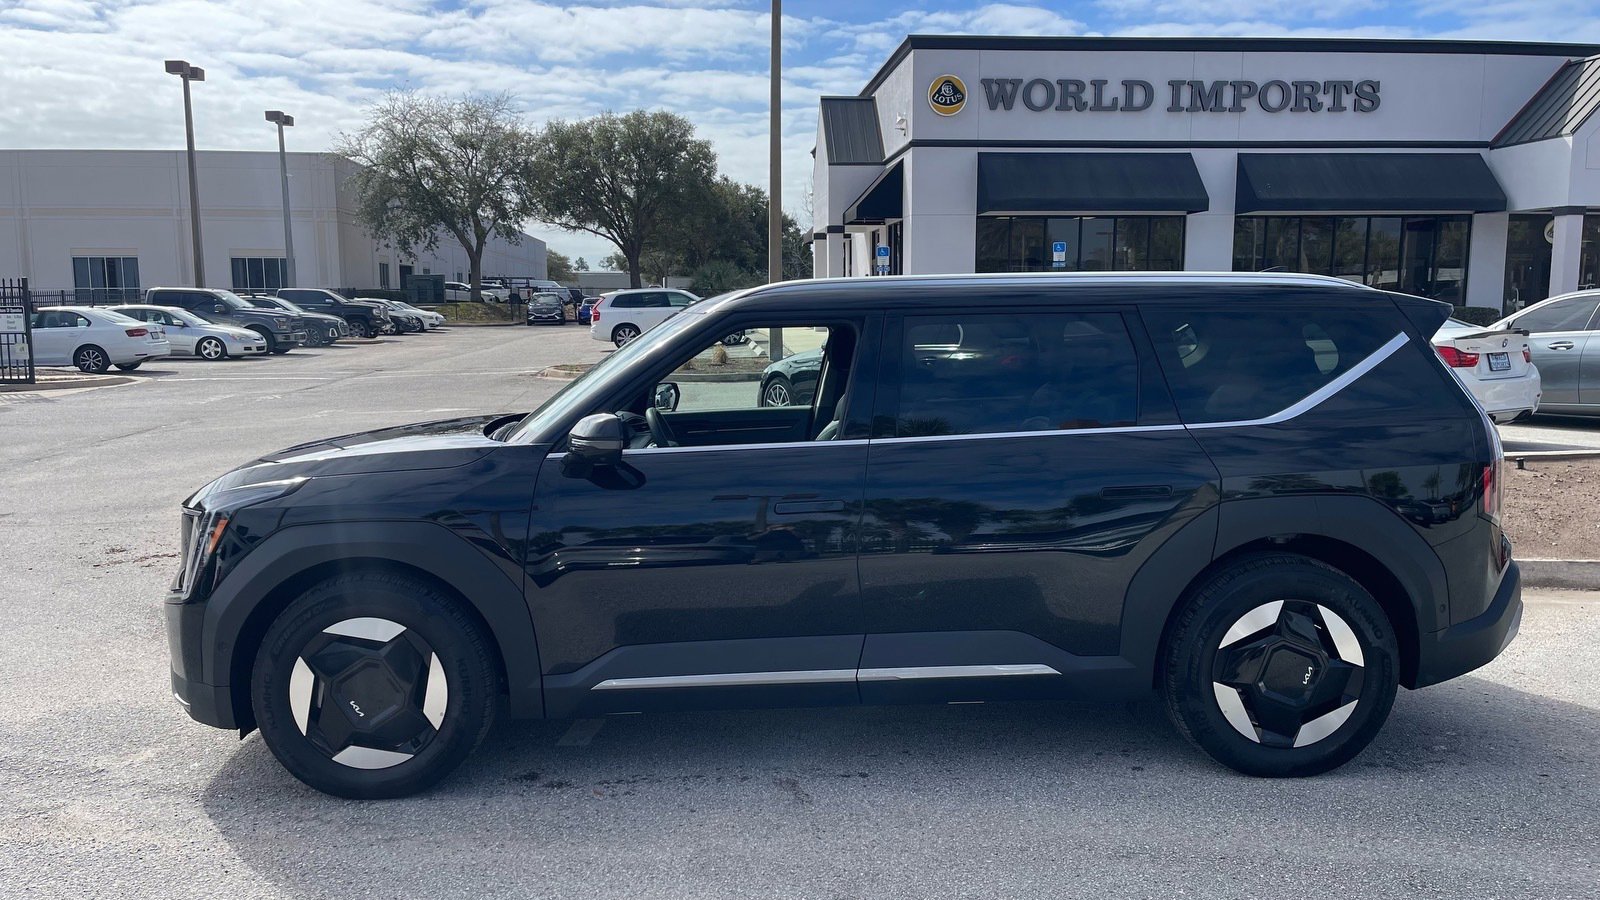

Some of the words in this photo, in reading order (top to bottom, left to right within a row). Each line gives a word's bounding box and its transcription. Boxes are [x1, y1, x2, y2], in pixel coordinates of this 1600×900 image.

[933, 92, 963, 104] LOTUS
[980, 78, 1154, 112] WORLD
[1167, 79, 1381, 113] IMPORTS
